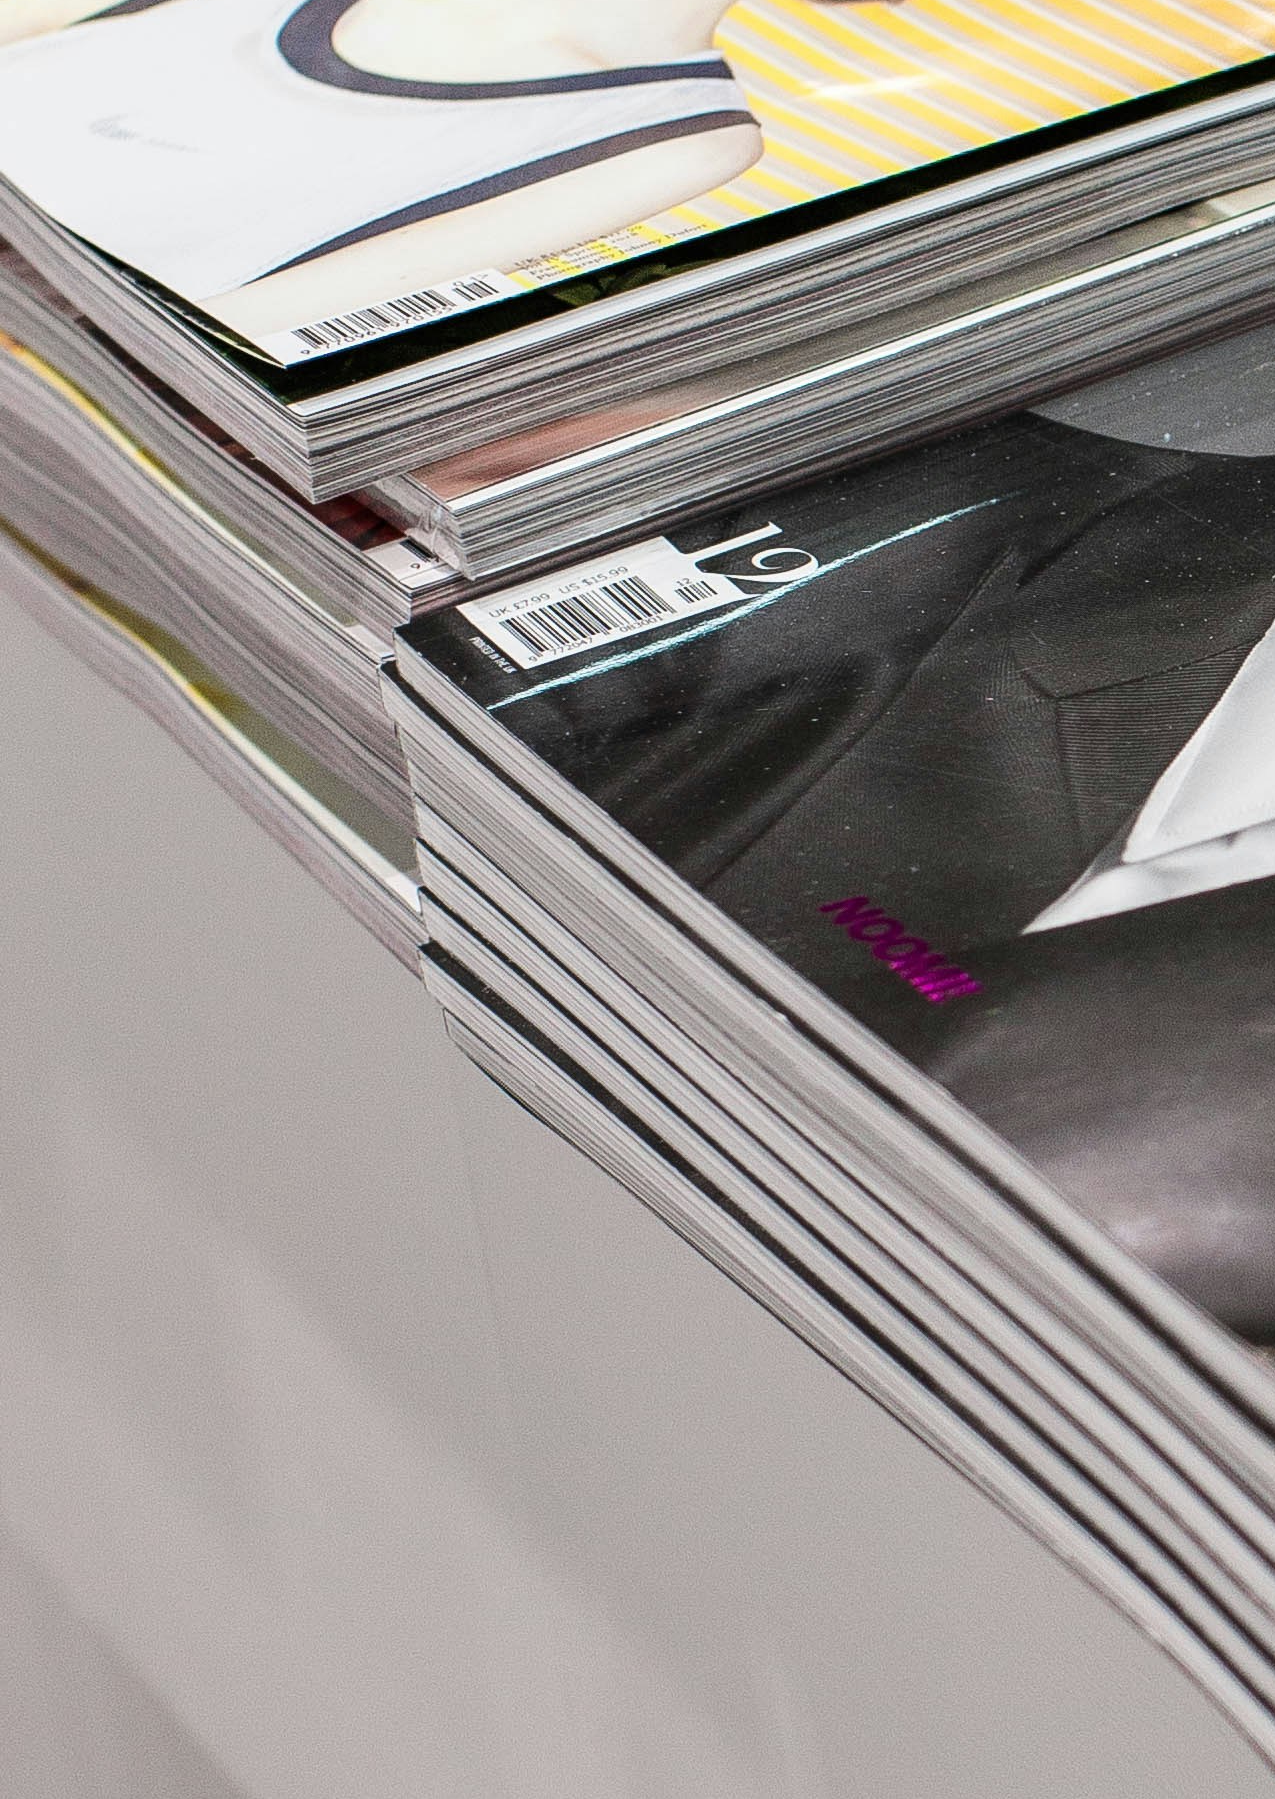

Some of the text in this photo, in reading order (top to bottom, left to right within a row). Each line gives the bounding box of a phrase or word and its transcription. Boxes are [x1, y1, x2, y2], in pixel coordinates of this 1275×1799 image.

[489, 565, 630, 619] UK £7.99 US $15.99
